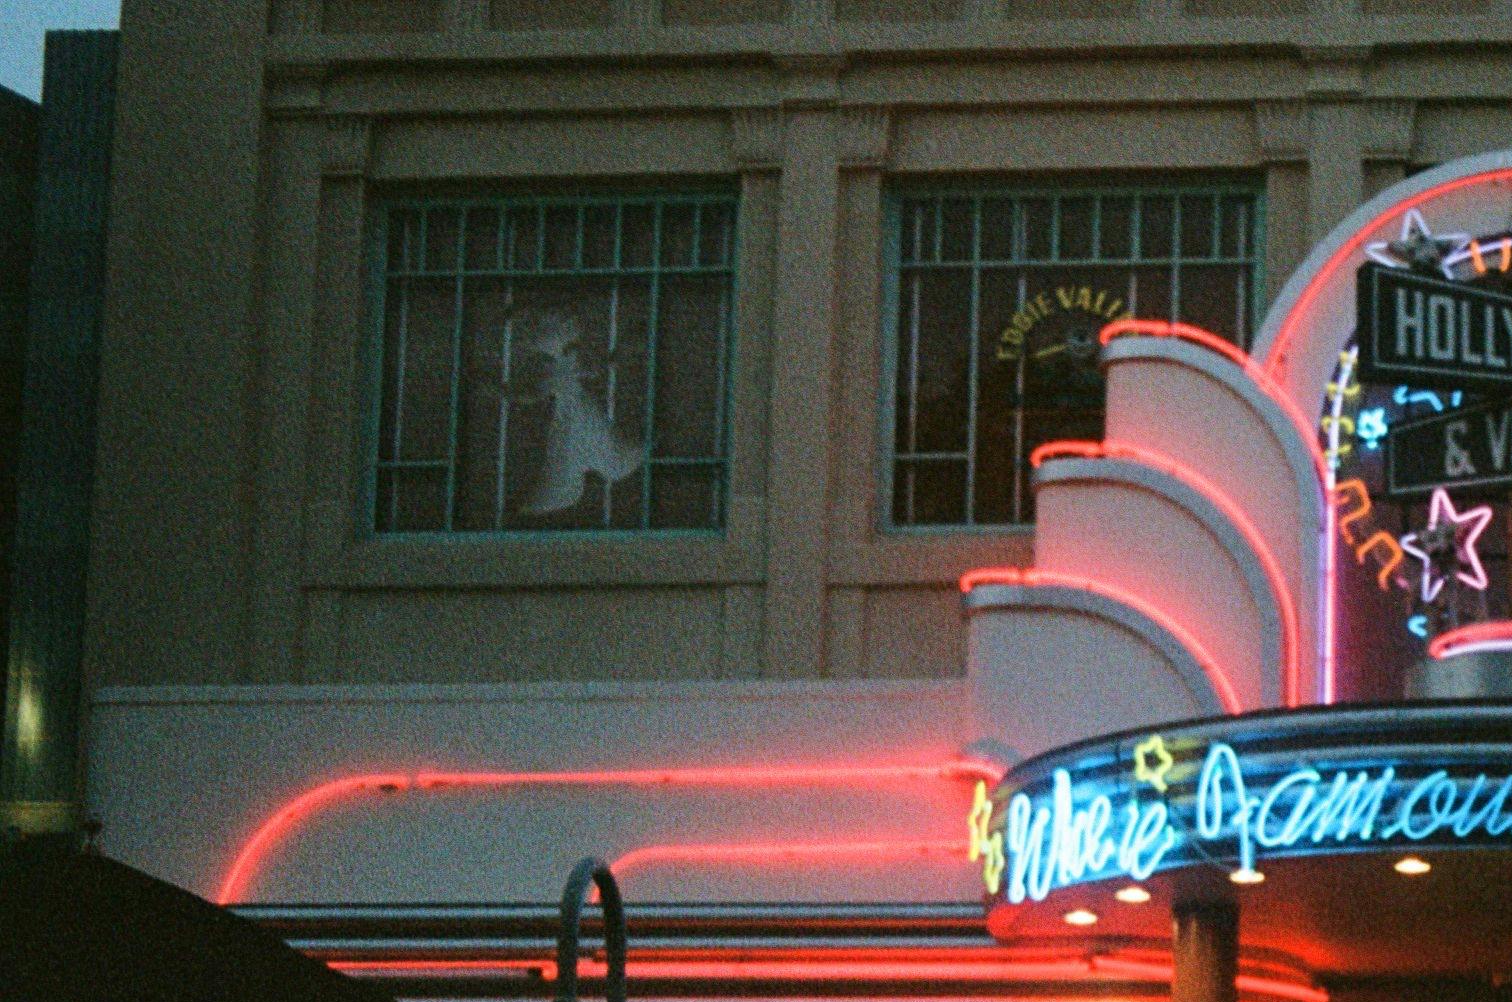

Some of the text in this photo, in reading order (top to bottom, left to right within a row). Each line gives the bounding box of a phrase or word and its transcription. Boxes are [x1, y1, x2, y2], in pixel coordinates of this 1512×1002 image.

[1056, 286, 1134, 319] VALI
[1444, 420, 1476, 477] &
[1008, 768, 1174, 904] Where
